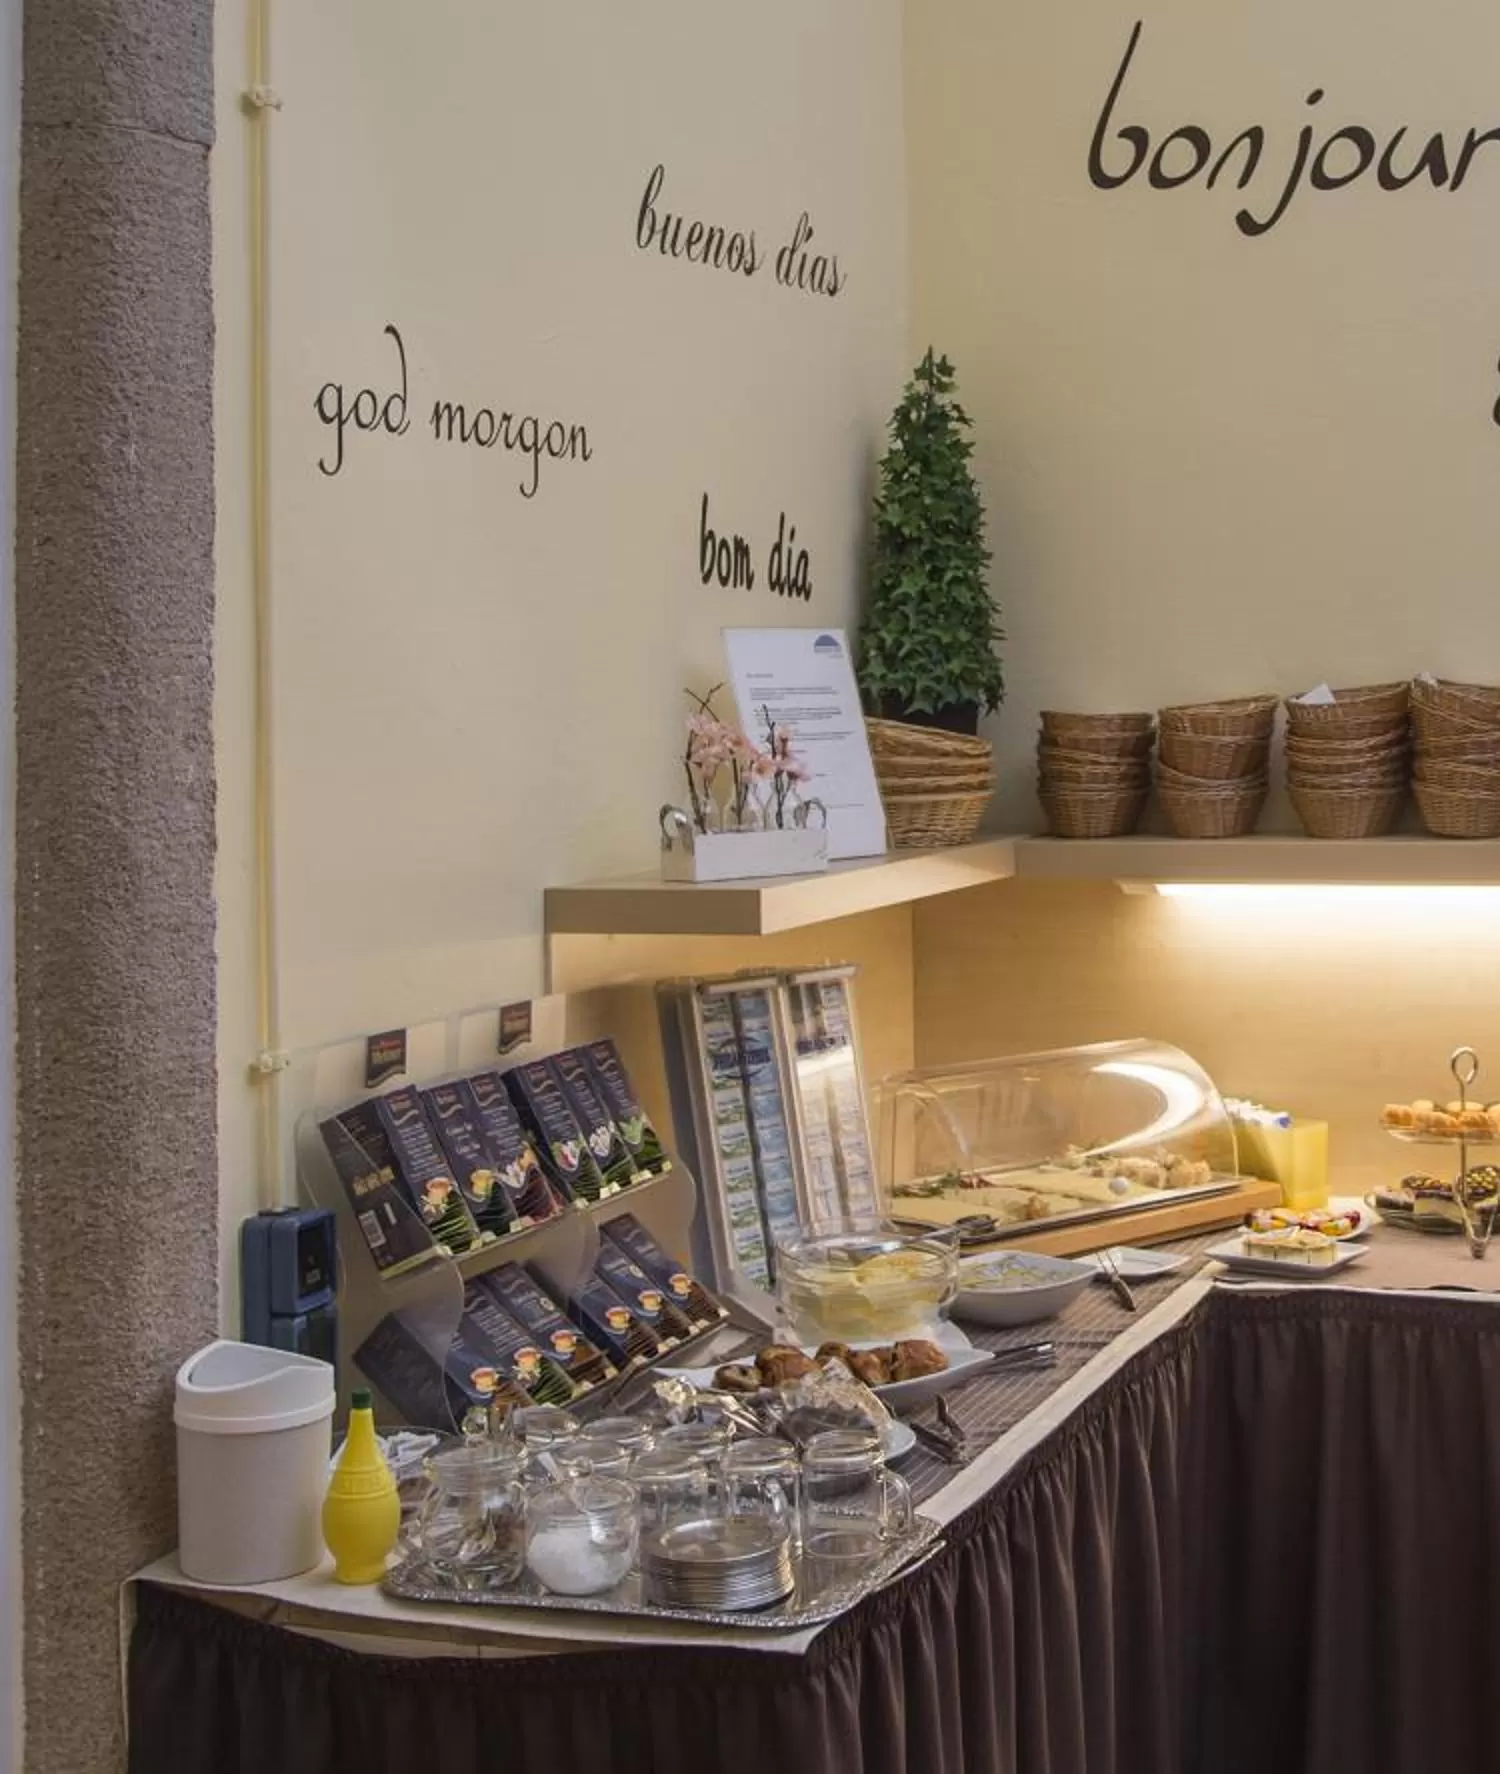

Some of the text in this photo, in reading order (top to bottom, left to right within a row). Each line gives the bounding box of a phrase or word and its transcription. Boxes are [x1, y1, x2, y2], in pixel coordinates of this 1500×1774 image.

[636, 163, 766, 277] buenos
[313, 323, 593, 499] god morgon
[699, 492, 813, 603] bom dia
